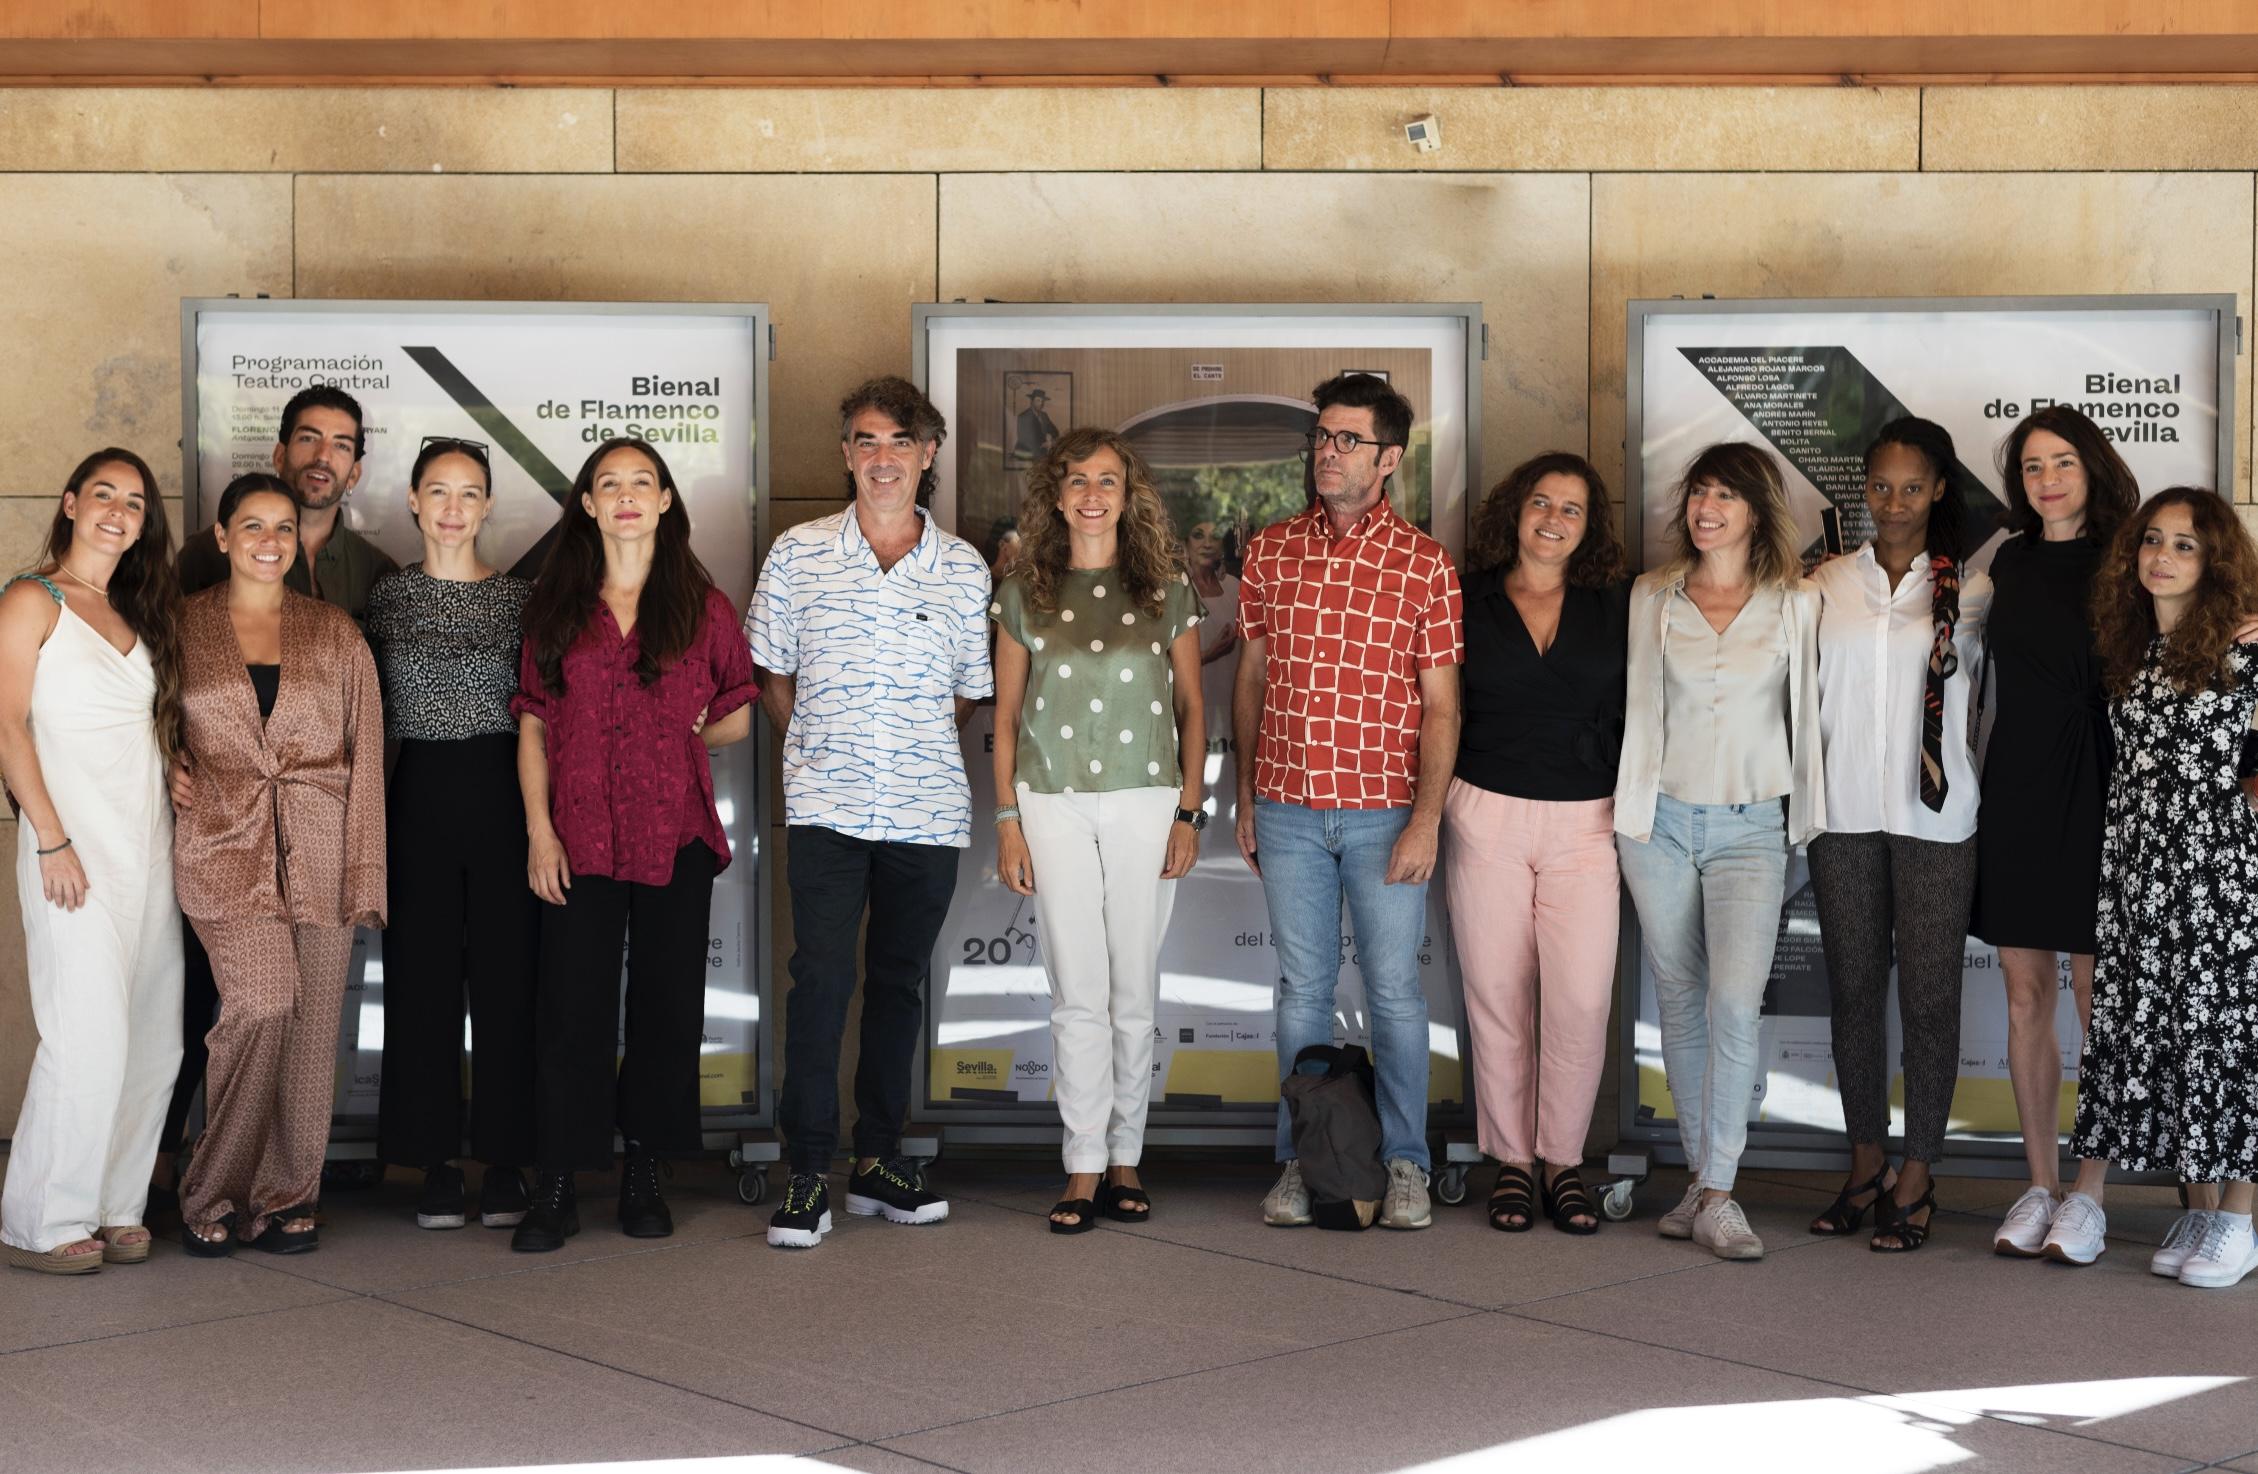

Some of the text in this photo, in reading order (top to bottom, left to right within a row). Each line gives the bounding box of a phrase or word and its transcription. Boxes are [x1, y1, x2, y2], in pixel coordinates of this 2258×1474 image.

[232, 355, 383, 373] Programación
[1768, 356, 1804, 364] PIACERE
[1708, 365, 1825, 373] ALEJANDRO ROJAS MARCOS
[232, 374, 389, 389] Teatro Central
[632, 375, 719, 396] Bienal
[1716, 374, 1780, 382] ALFONSO LOSA
[2085, 372, 2180, 394] Bienal
[1735, 391, 1818, 400] ÁLVARO MARTINETE
[536, 400, 719, 419] de Flamenco
[1753, 409, 1816, 417] ANDRÉS MARÍN
[1984, 399, 2180, 418] de Fmenco
[581, 423, 719, 443] de Sevilla
[2100, 421, 2180, 442] evilla
[1830, 455, 1864, 463] MARTÍN
[1808, 465, 1844, 473] CLAUDIA
[1816, 474, 1837, 482] DANI
[1838, 474, 1850, 482] DE
[1234, 932, 1263, 947] del
[1963, 954, 1991, 969] del
